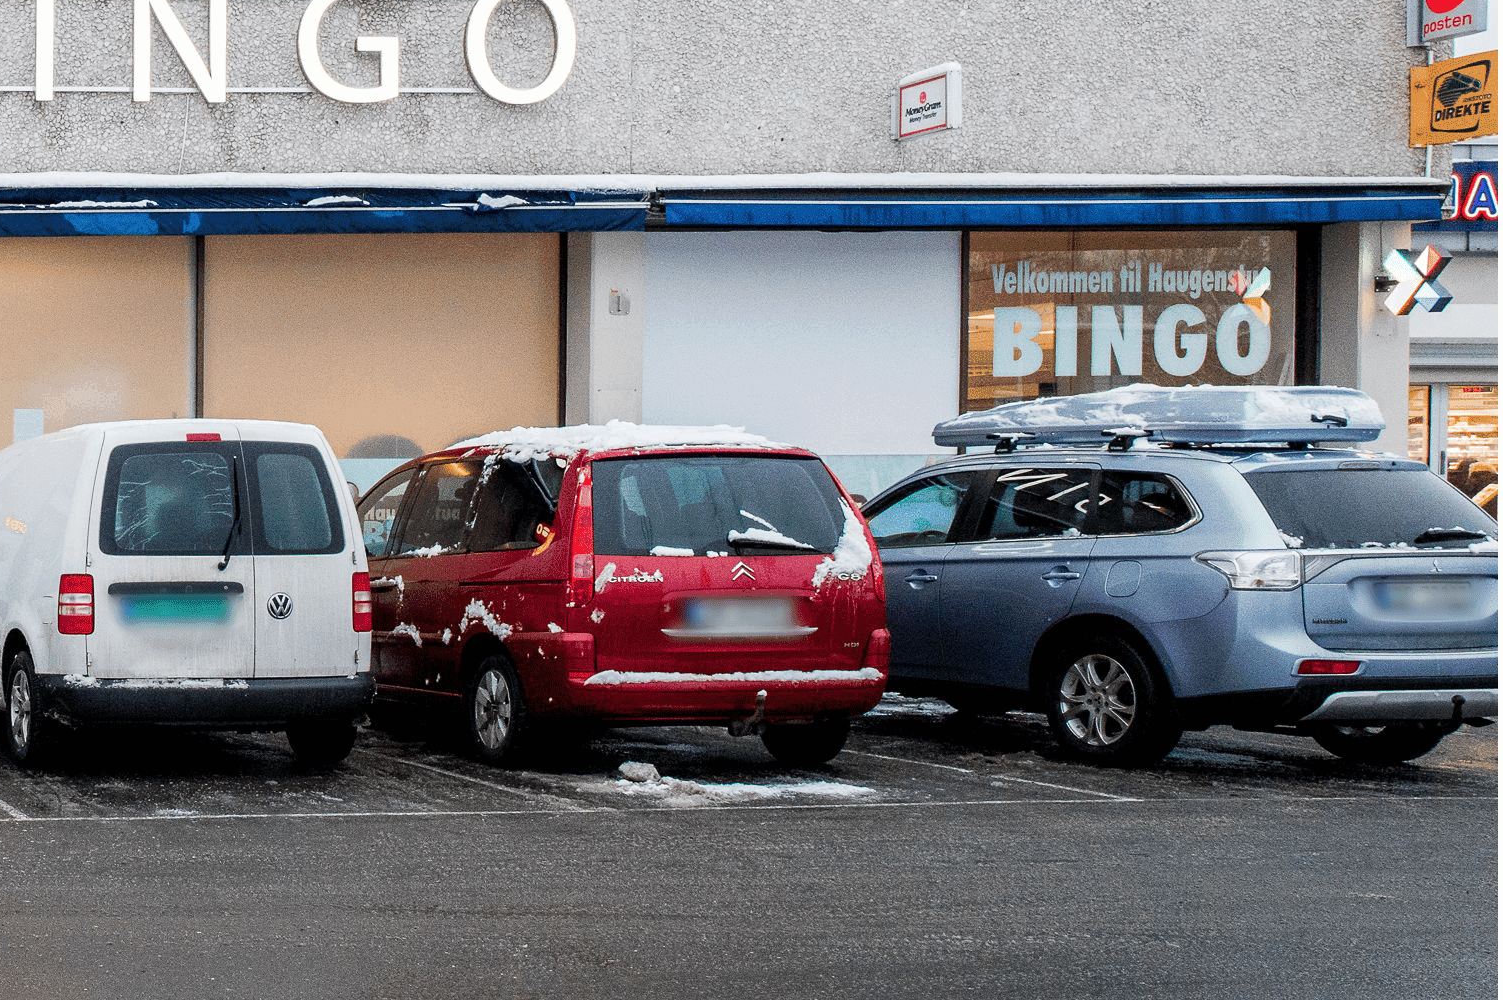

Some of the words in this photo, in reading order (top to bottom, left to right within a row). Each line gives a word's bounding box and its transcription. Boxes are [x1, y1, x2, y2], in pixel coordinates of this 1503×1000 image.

[1422, 13, 1472, 36] posten
[1434, 100, 1490, 123] DIREKTE
[992, 261, 1113, 294] Velkommen
[1120, 261, 1142, 293] til
[992, 303, 1271, 377] BINGO
